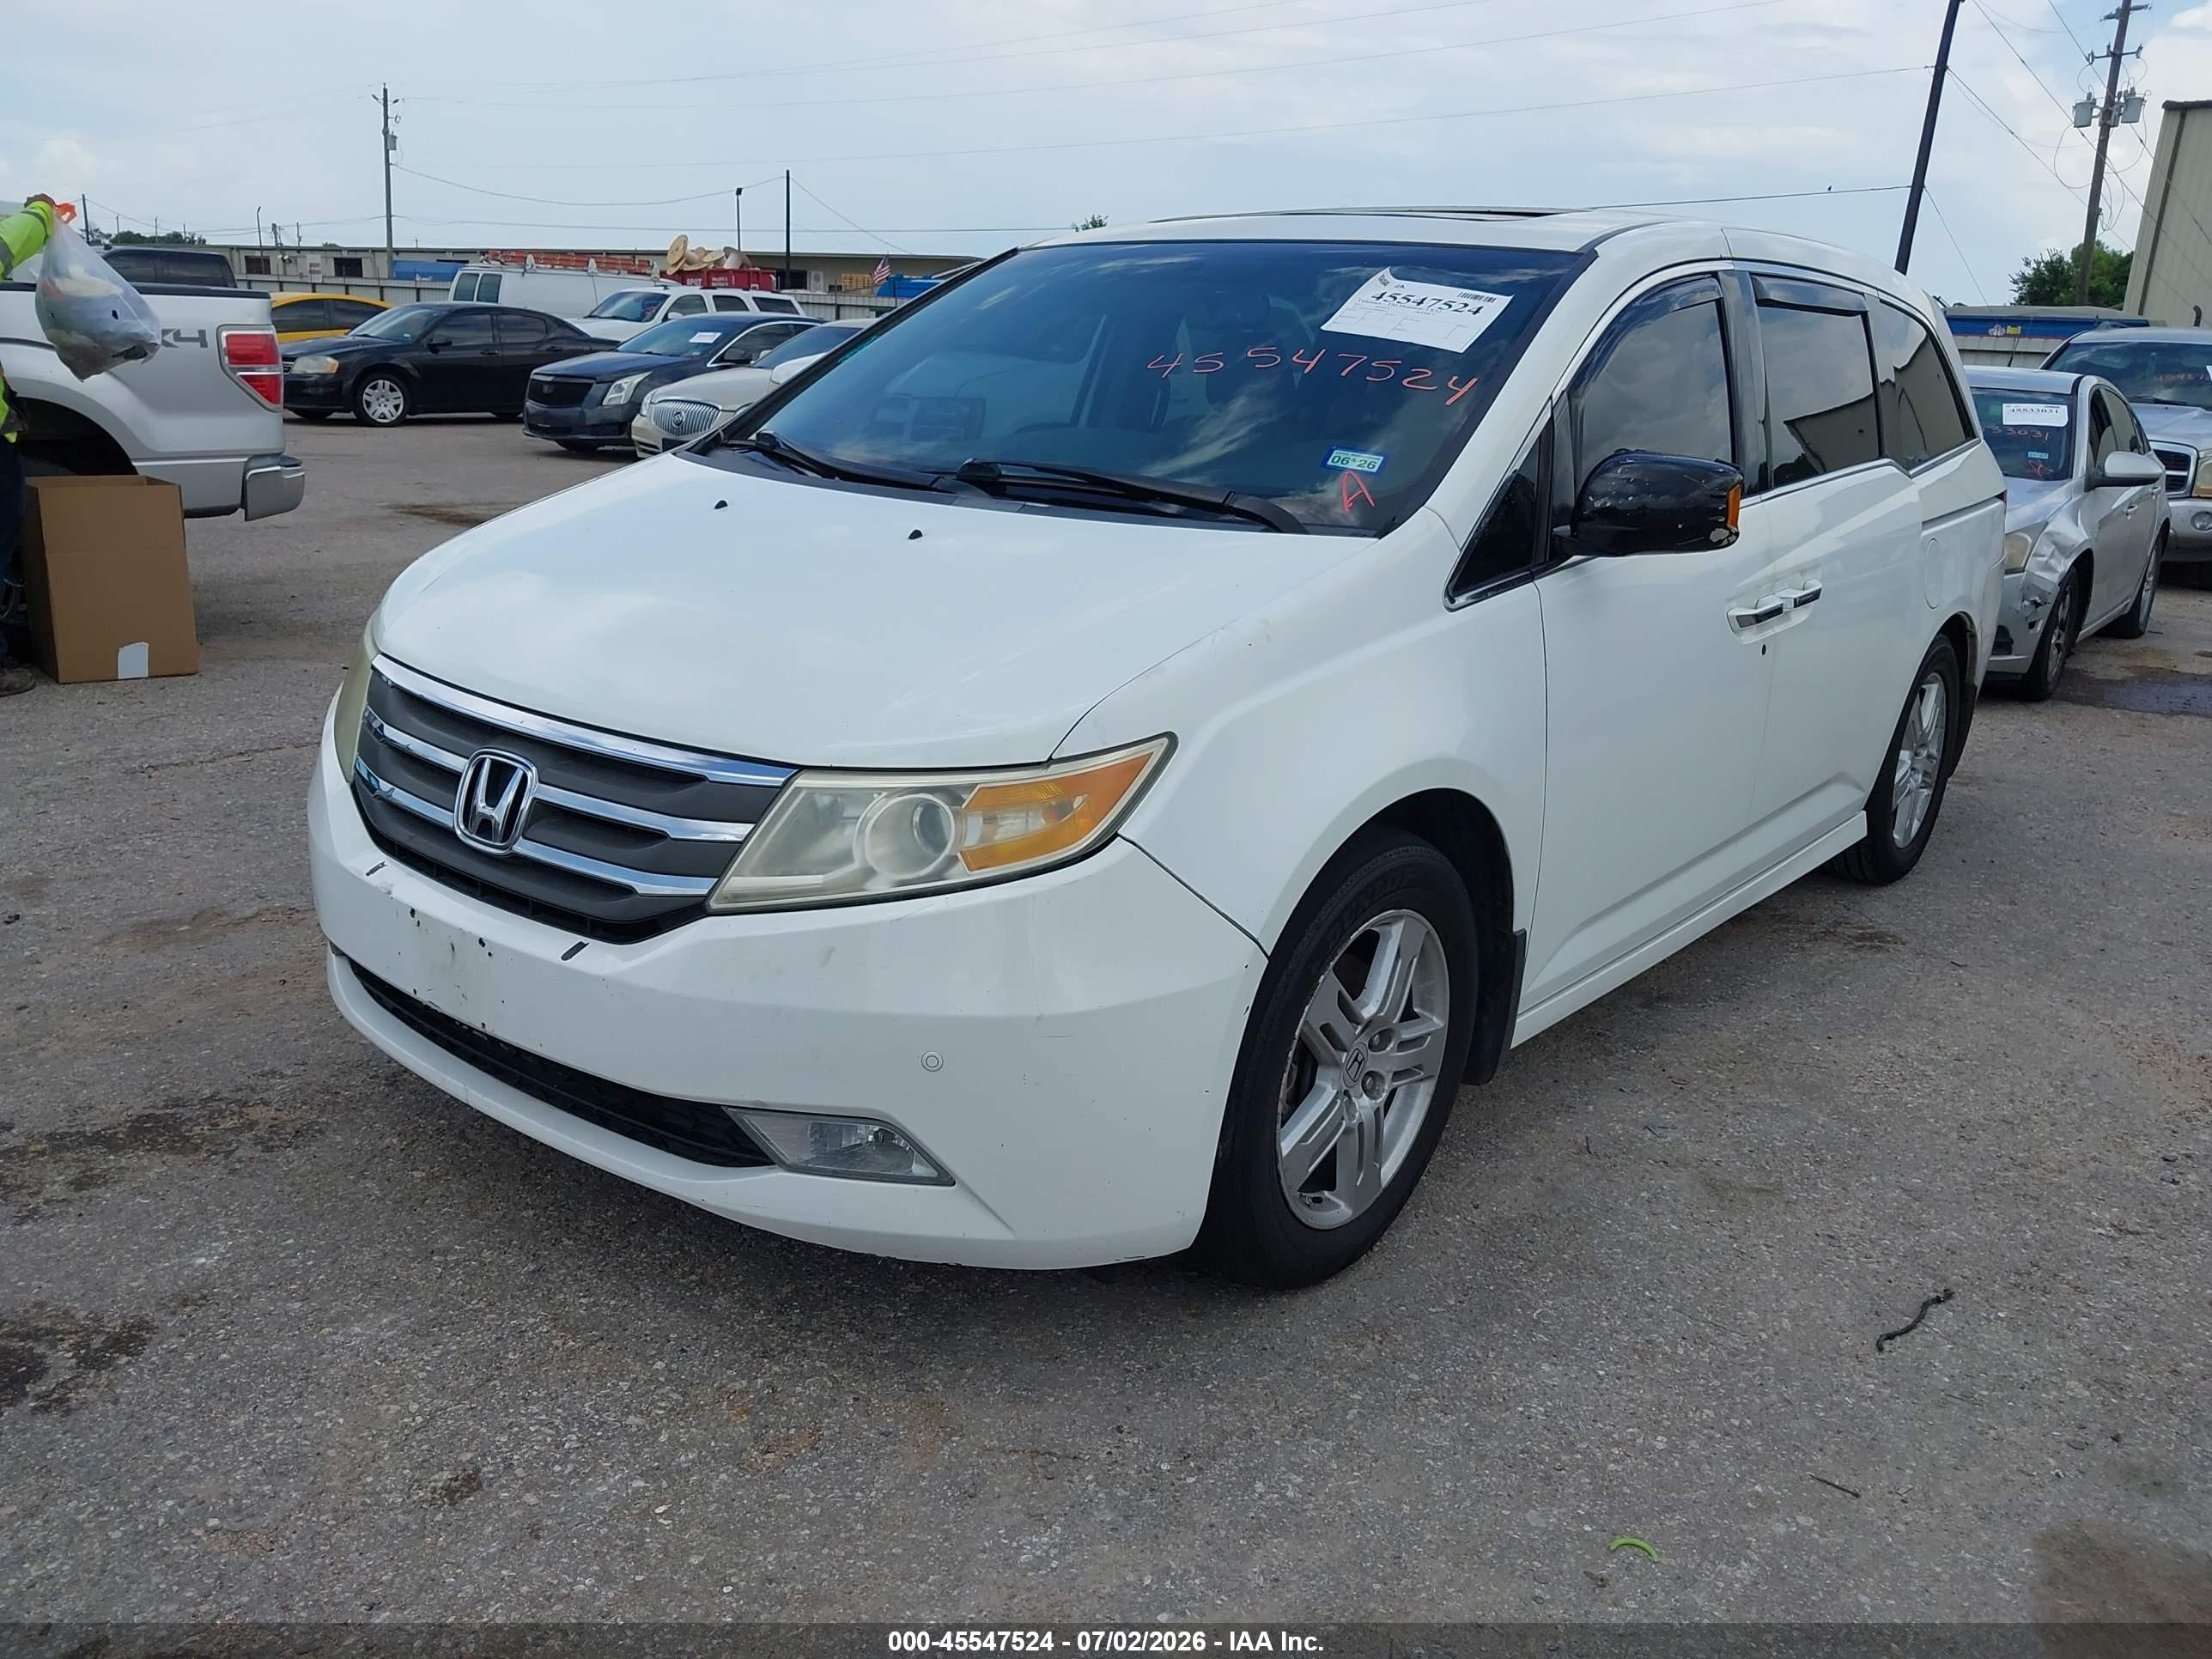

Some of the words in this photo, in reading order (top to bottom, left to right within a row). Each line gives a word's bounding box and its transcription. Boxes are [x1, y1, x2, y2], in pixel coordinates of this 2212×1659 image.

[1371, 291, 1485, 316] 45547524
[1330, 455, 1351, 465] 06
[1356, 459, 1378, 470] 26
[1341, 470, 1376, 514] A
